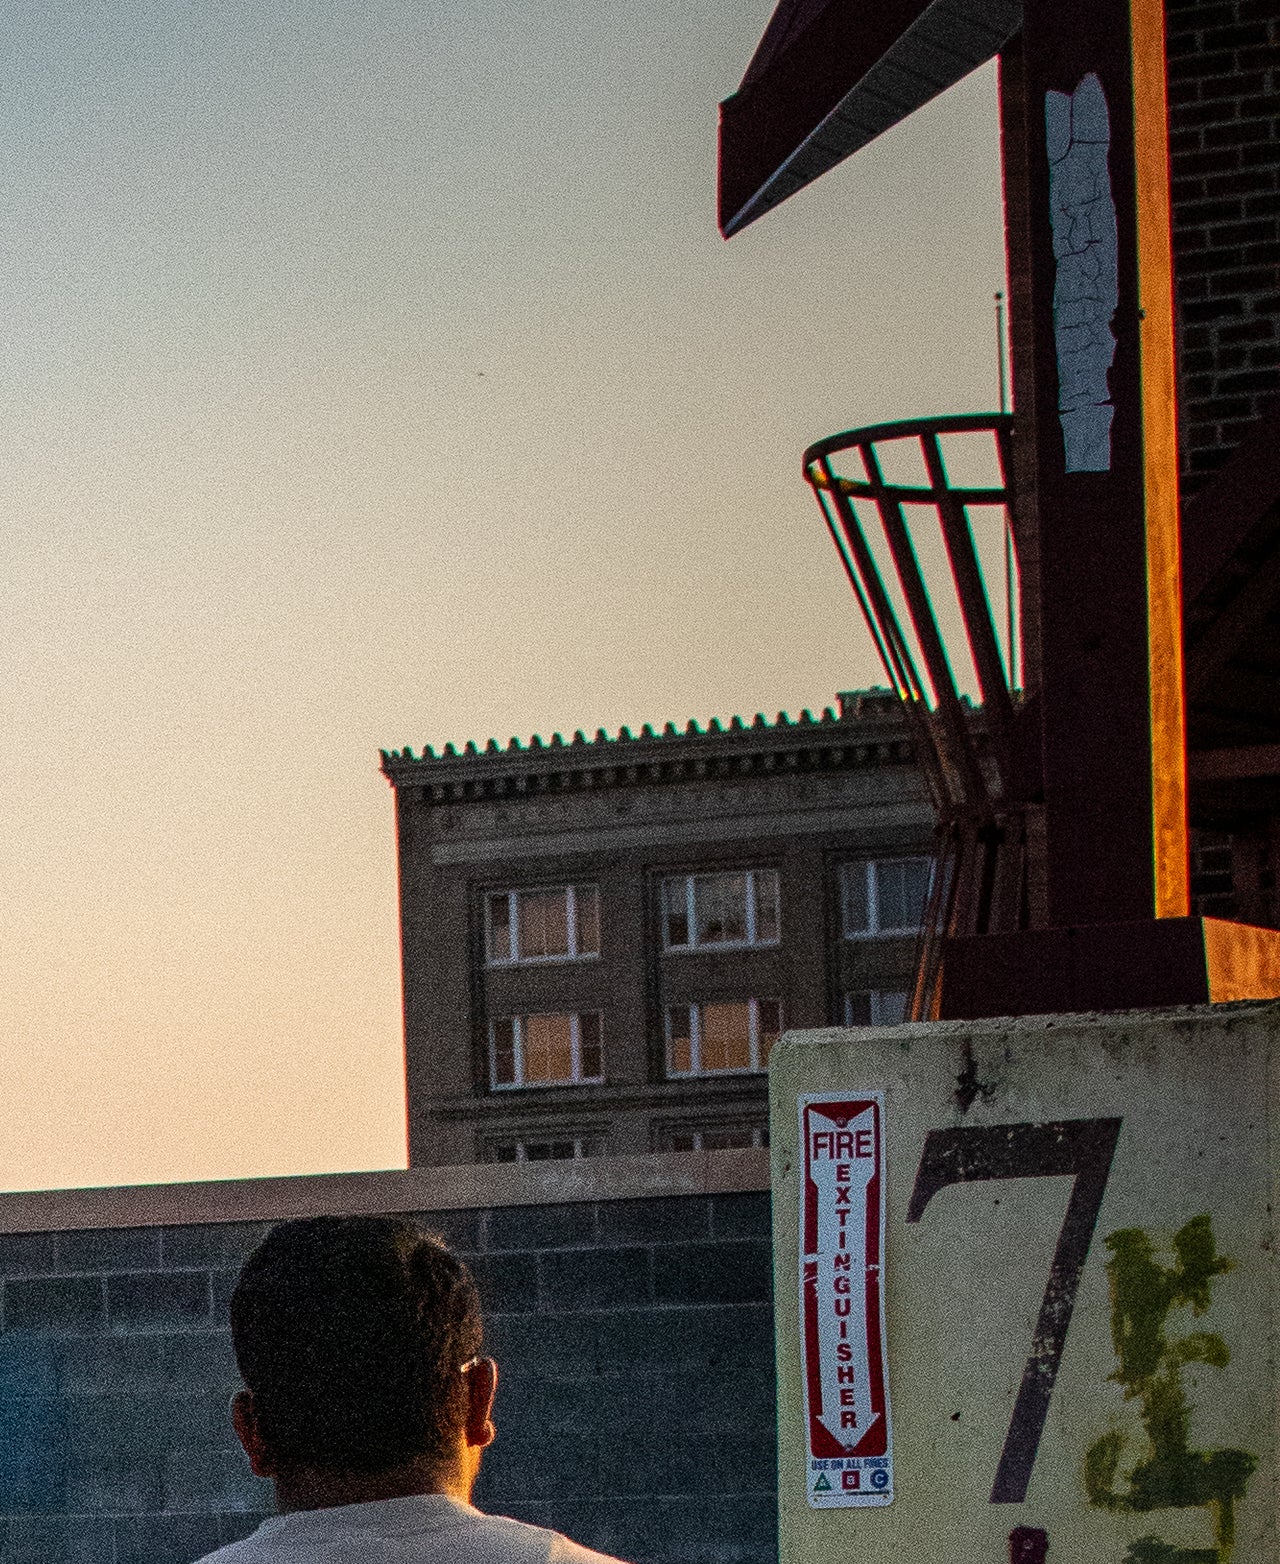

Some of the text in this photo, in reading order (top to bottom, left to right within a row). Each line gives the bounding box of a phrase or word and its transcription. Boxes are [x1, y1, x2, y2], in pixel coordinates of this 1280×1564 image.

[813, 1130, 872, 1160] FIRE
[833, 1164, 858, 1429] EXTINGUISHER
[905, 1116, 1124, 1504] 7
[811, 1459, 829, 1471] USE
[831, 1459, 844, 1470] ON
[846, 1458, 862, 1469] ALL
